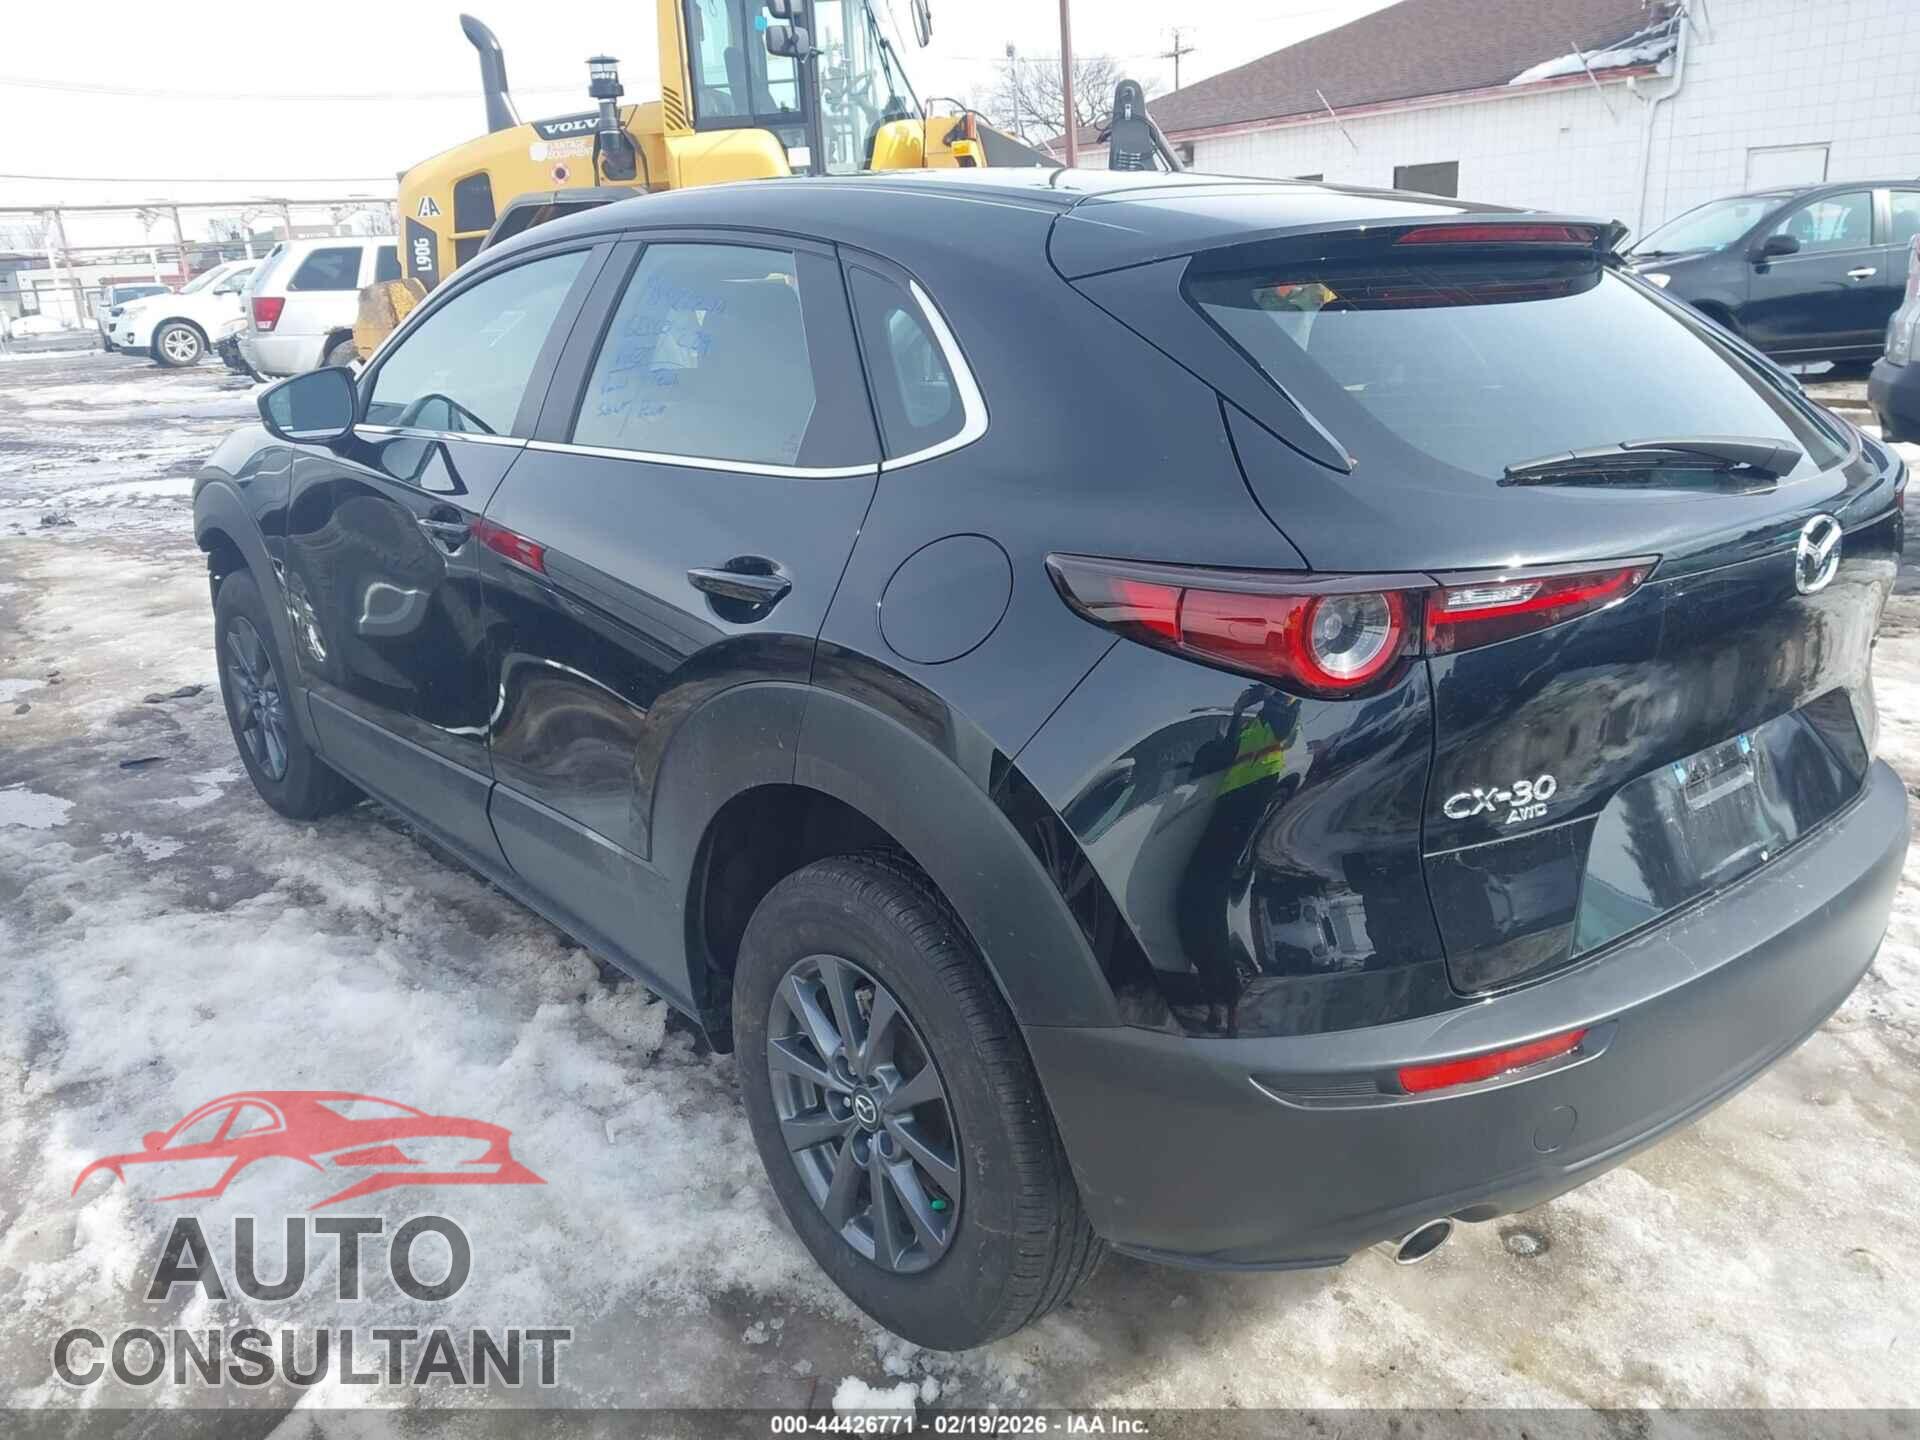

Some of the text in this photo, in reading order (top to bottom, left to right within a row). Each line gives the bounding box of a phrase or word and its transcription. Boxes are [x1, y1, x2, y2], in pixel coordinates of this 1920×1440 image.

[544, 118, 600, 134] VOLV
[1443, 774, 1558, 819] CX-30
[1504, 802, 1548, 825] AWD
